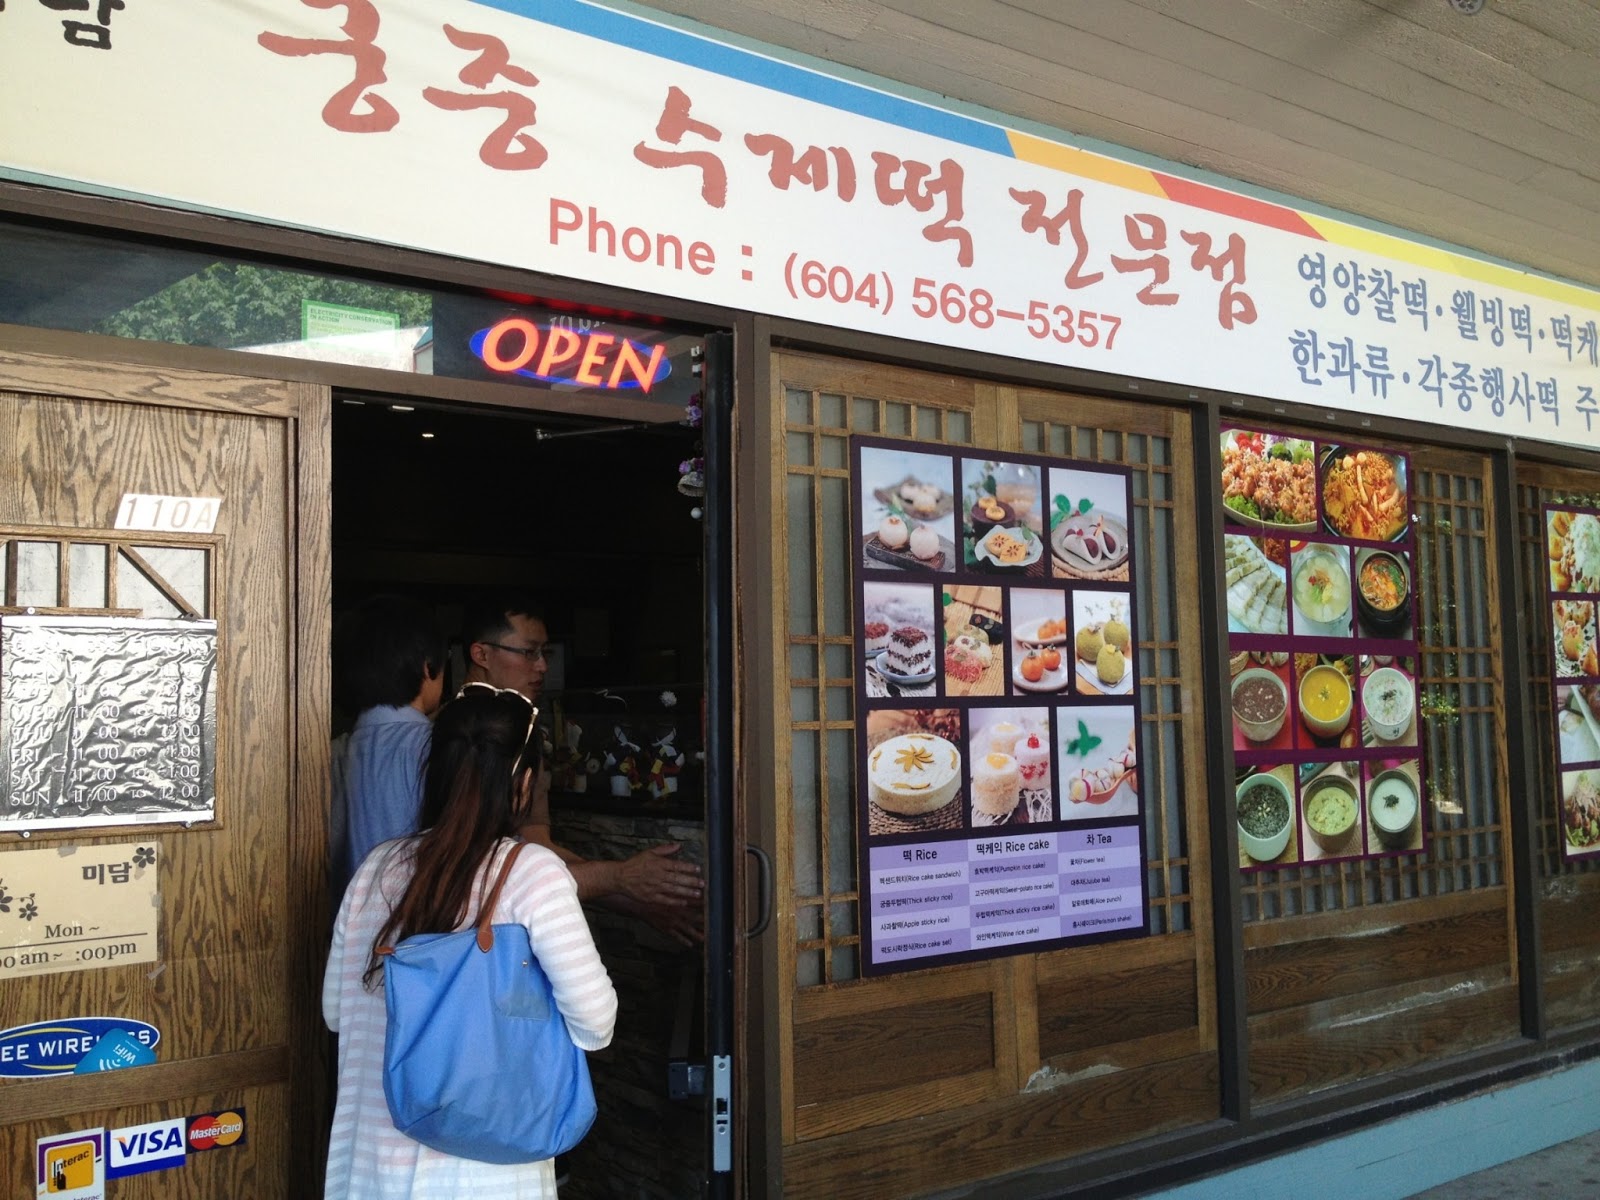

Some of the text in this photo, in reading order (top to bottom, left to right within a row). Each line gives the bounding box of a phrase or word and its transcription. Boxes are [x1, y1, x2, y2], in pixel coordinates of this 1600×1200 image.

[257, 0, 1260, 330] 궁중 수제떡 전문점
[549, 197, 716, 275] Phone
[783, 250, 894, 316] (604)
[911, 278, 1123, 350] 568-5357
[311, 308, 394, 326] ELECTRICITY CONSERVATION
[482, 318, 665, 394] OPEN
[1575, 385, 1600, 432] 주
[125, 497, 213, 530] 110A
[11, 748, 40, 763] FRI
[11, 768, 45, 785] SAT
[10, 791, 51, 806] SUN
[181, 785, 200, 798] 00
[976, 838, 1050, 856] 떡케익 Rice cake
[1086, 833, 1112, 846] 차 Tea
[903, 848, 938, 863] 떡 Rice
[82, 862, 132, 885] 미담
[920, 873, 933, 881] cake
[935, 870, 961, 879] sandwich)
[1021, 863, 1031, 871] rice
[1032, 862, 1045, 870] cake)
[1033, 883, 1041, 891] rice
[1042, 882, 1054, 890] cake)
[924, 894, 939, 903] sticky
[940, 893, 953, 901] rice)
[1015, 906, 1029, 914] sticky
[1041, 903, 1054, 911] cake)
[920, 918, 936, 926] sticky
[937, 916, 949, 924] rice)
[45, 922, 83, 940] Mon
[1026, 927, 1039, 935] cake)
[927, 940, 940, 948] cake
[942, 938, 952, 946] set)
[39, 1029, 151, 1057] WIRES
[113, 1044, 136, 1064] WiFi
[190, 1121, 242, 1141] MasterCard
[115, 1127, 183, 1158] VISA
[53, 1150, 90, 1179] Interac
